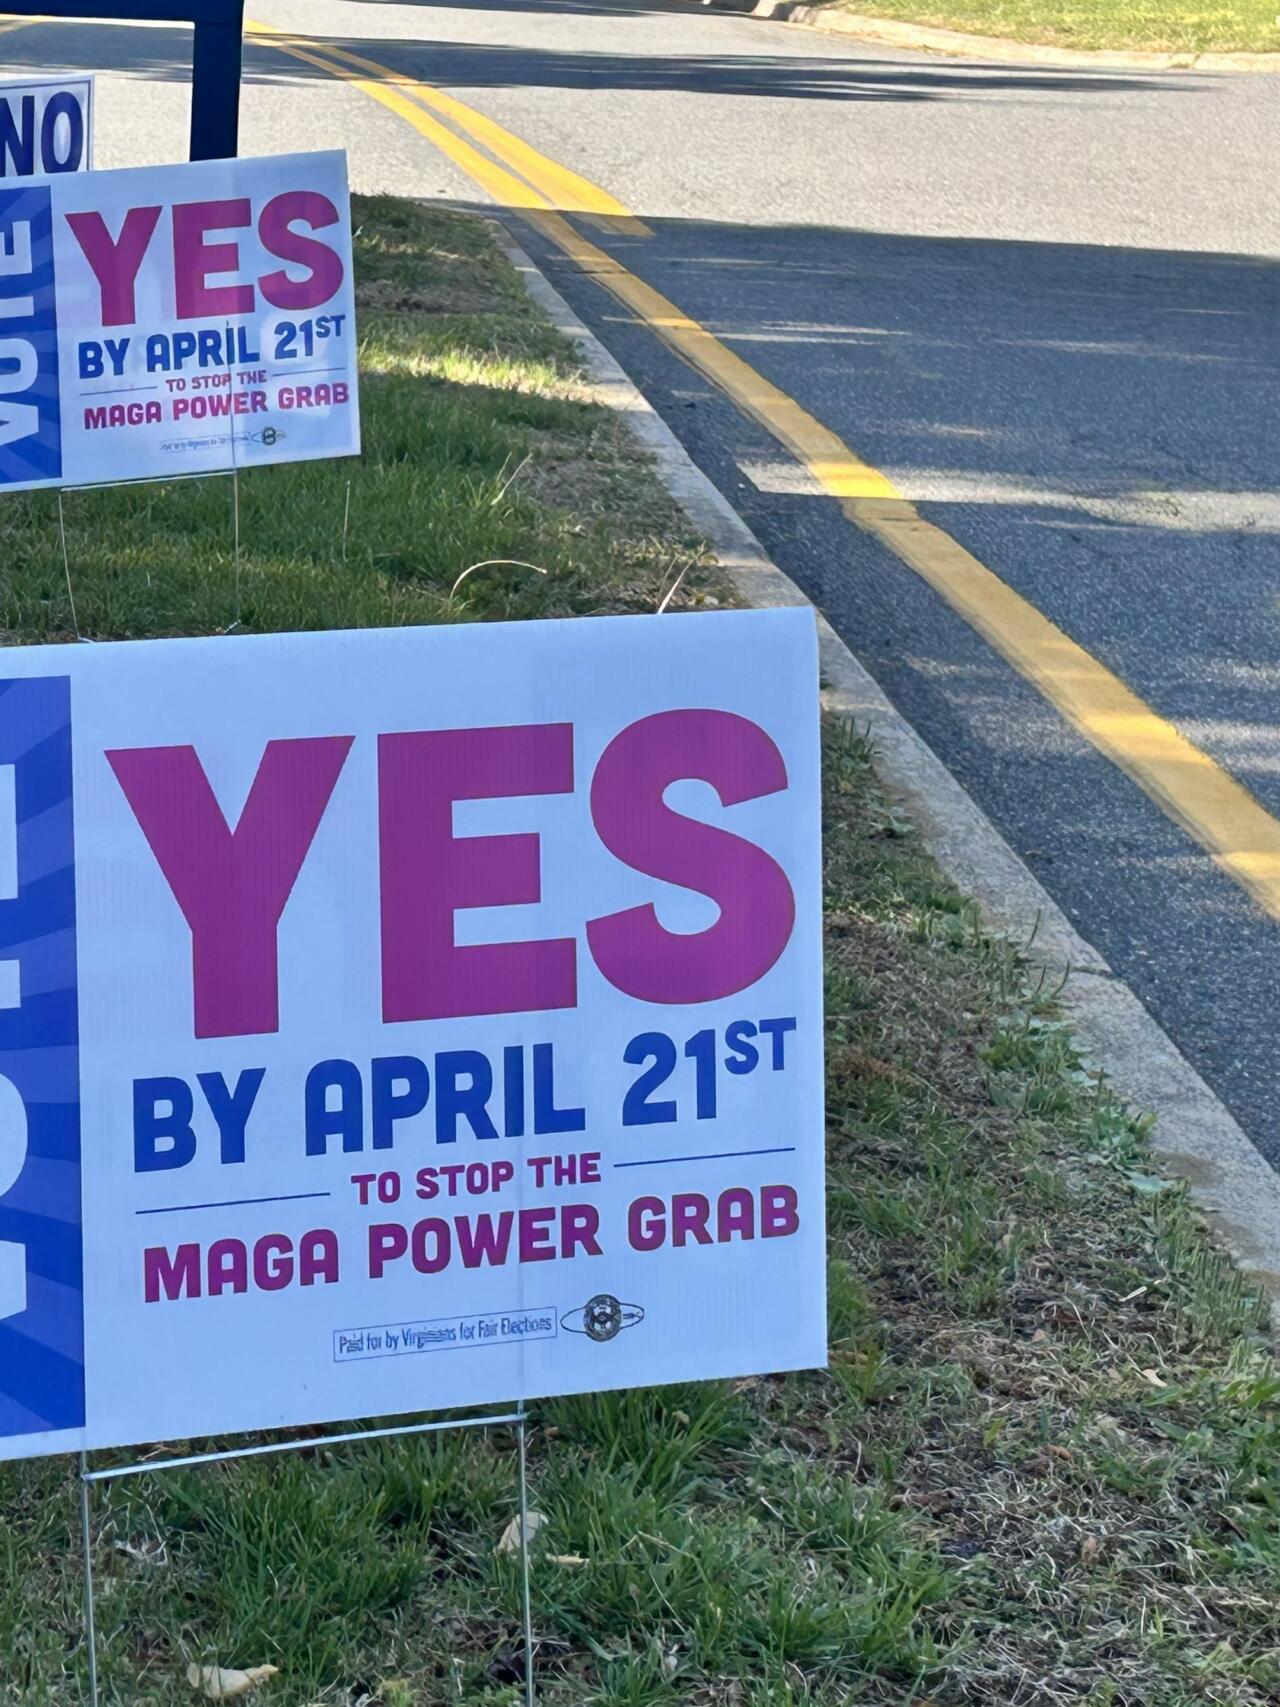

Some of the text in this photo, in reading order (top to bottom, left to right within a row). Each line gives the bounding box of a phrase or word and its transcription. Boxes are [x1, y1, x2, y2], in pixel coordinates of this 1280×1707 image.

[65, 191, 344, 326] YES
[79, 315, 345, 378] BY APRIL 21ST
[84, 382, 349, 430] MAGA POWER GRAB
[166, 370, 267, 393] TO STOP THE
[104, 709, 795, 1039] YES
[133, 1018, 796, 1172] BY APRIL 21ST
[351, 1152, 601, 1205] TO STOP THE
[145, 1185, 799, 1302] MAGA POWER GRAB
[339, 1330, 364, 1354] Paid
[366, 1332, 382, 1351] for
[385, 1329, 399, 1350] by
[459, 1321, 475, 1340] for
[478, 1319, 498, 1338] Fair
[500, 1316, 552, 1336] Elections
